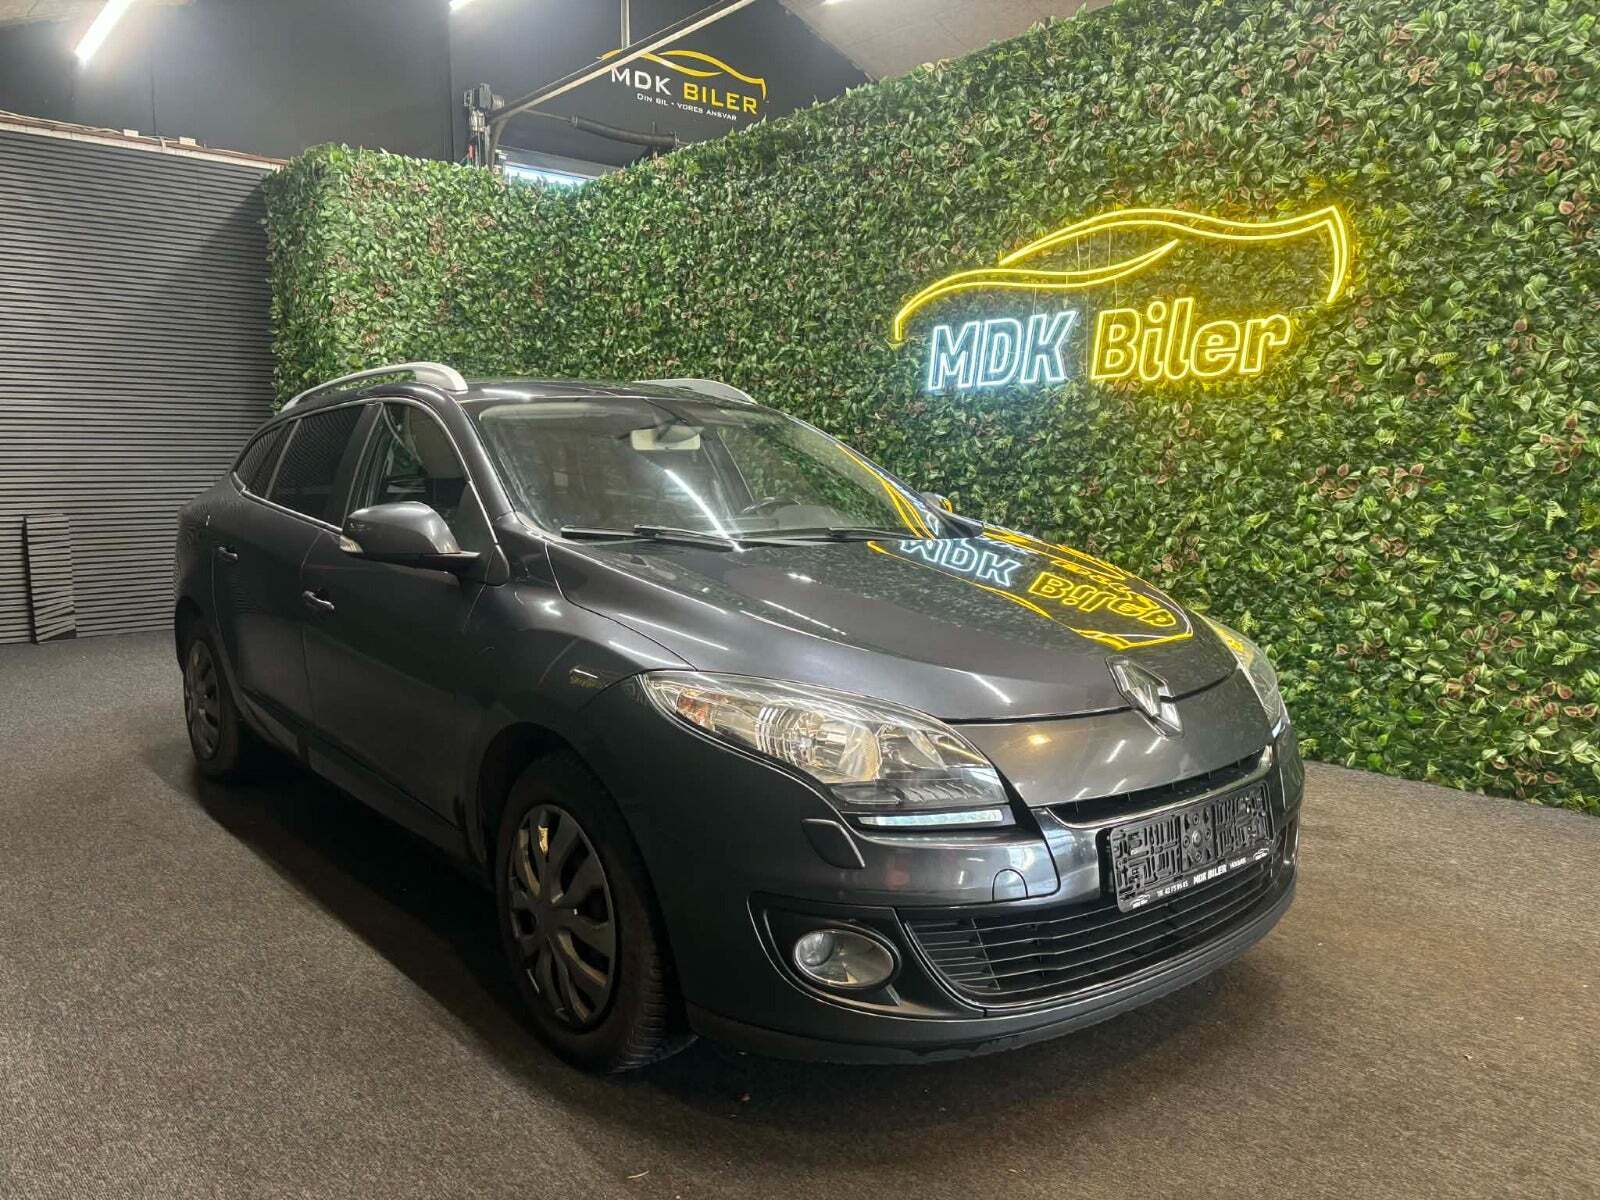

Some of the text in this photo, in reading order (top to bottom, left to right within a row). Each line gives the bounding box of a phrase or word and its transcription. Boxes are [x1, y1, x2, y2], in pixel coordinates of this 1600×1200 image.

[611, 66, 757, 115] MDK BILER
[636, 92, 737, 120] DIN BIL VORES ANSVAR
[928, 297, 1293, 391] MDK Biler
[1194, 872, 1207, 885] MDK
[1207, 864, 1227, 880] BILER
